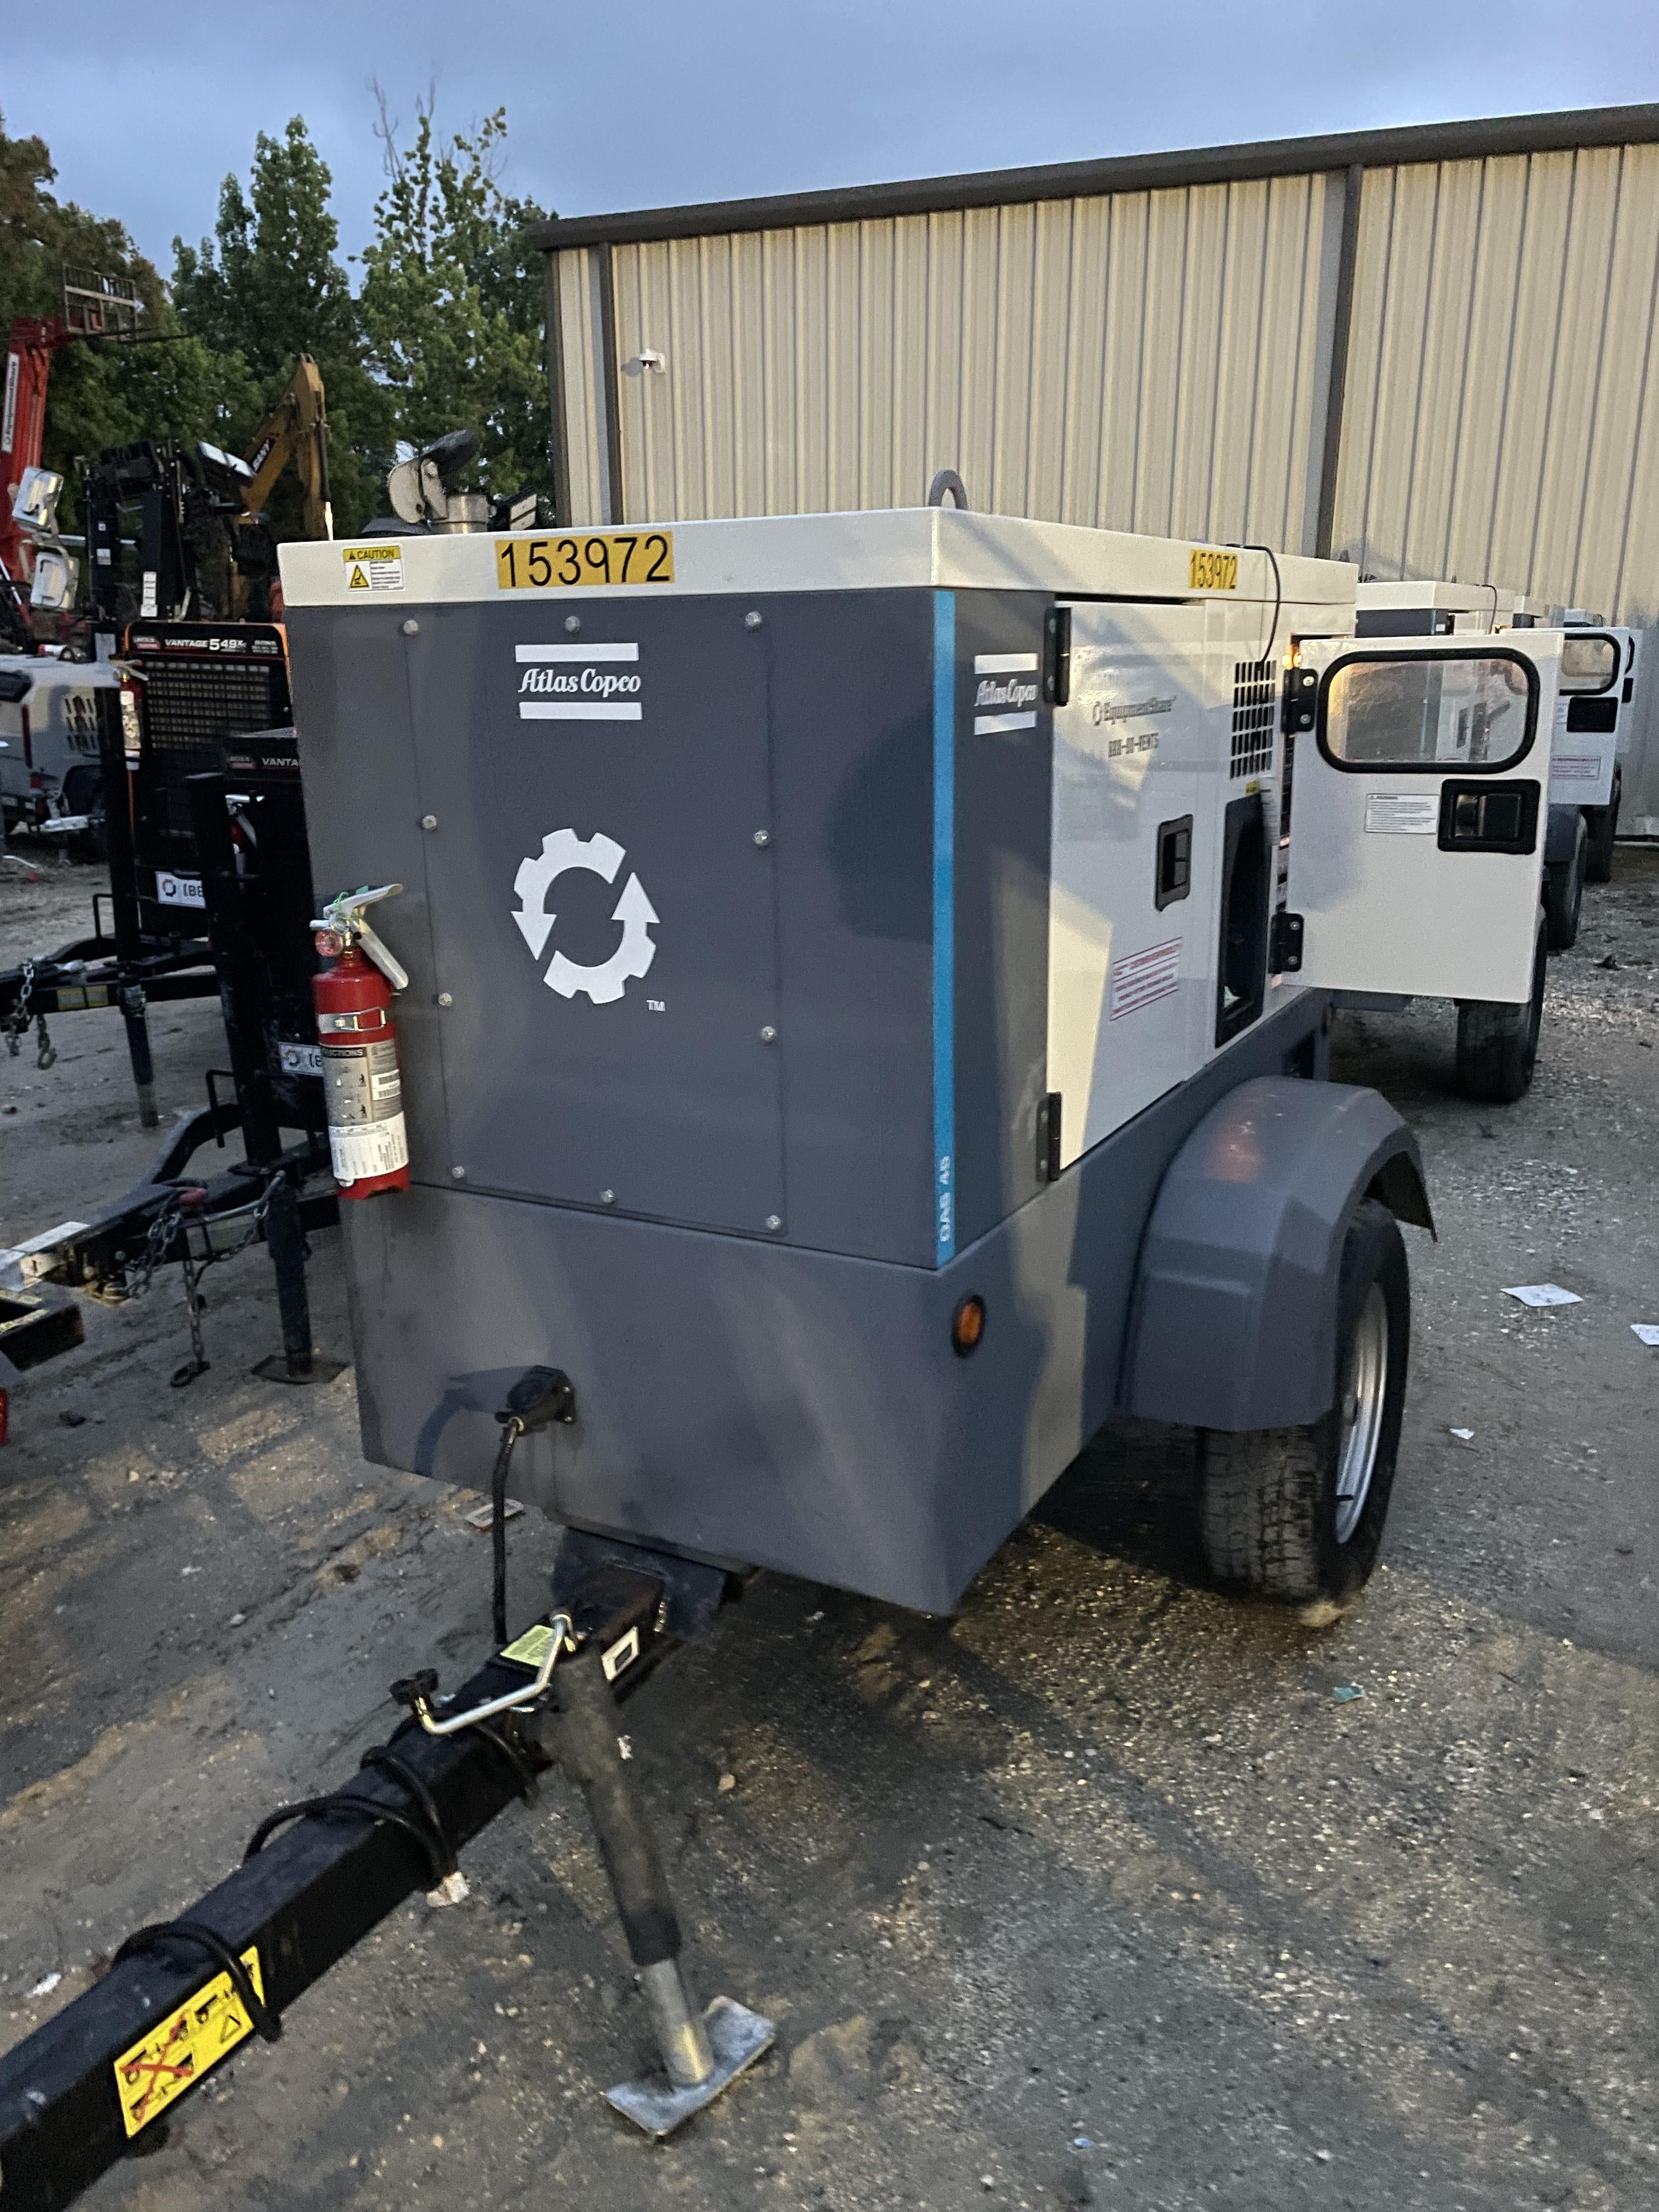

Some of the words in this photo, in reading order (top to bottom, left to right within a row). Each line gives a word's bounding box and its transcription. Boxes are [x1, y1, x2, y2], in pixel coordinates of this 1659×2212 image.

[357, 549, 394, 560] CAUTION
[501, 535, 670, 587] 153972
[1190, 552, 1237, 589] 153972
[165, 639, 208, 648] VANTAGE
